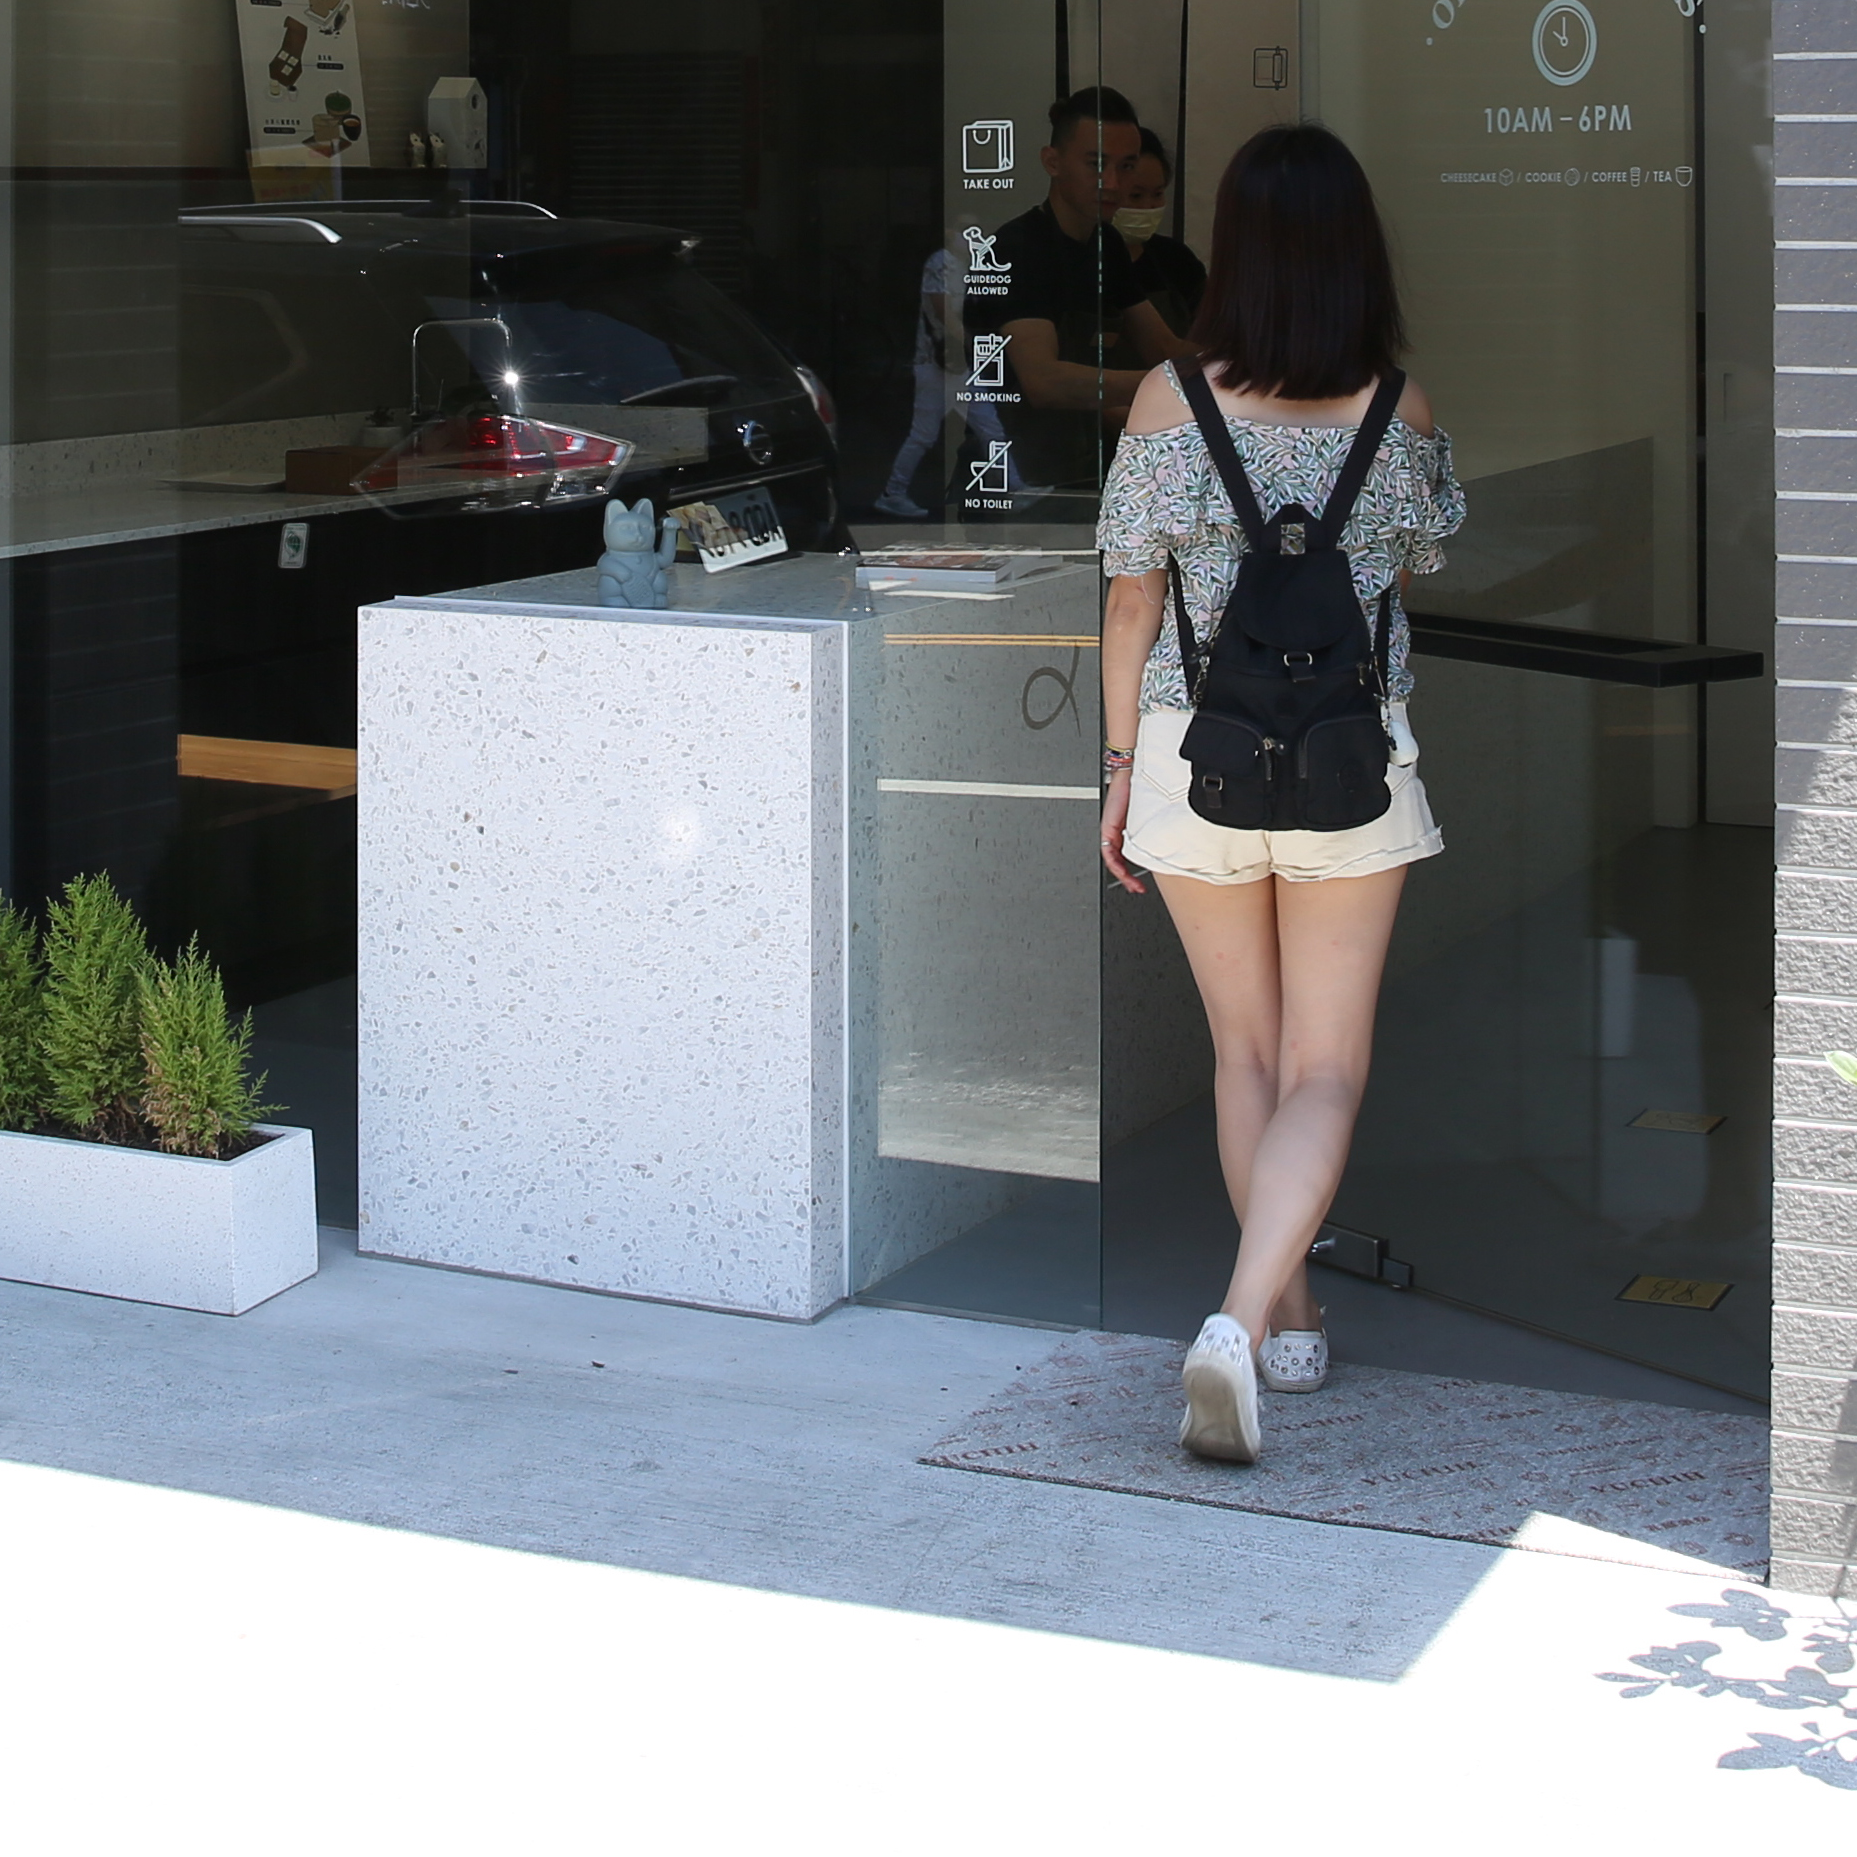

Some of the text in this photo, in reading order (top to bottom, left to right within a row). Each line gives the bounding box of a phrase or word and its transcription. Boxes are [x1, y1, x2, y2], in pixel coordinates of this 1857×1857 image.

[1483, 105, 1553, 134] 10AM
[1578, 104, 1632, 132] 6PM
[1440, 171, 1497, 183] CHEESECAKE
[1525, 171, 1562, 183] COOKIE
[1591, 171, 1628, 183] COFFEE
[1652, 170, 1673, 183] TEA
[963, 178, 1014, 190] TAKE OUT
[963, 274, 1012, 285] GUIDEDOG
[966, 285, 1009, 296] ALLOWED
[956, 392, 1021, 404] NO SMOKING
[964, 498, 1013, 510] NO TOILET
